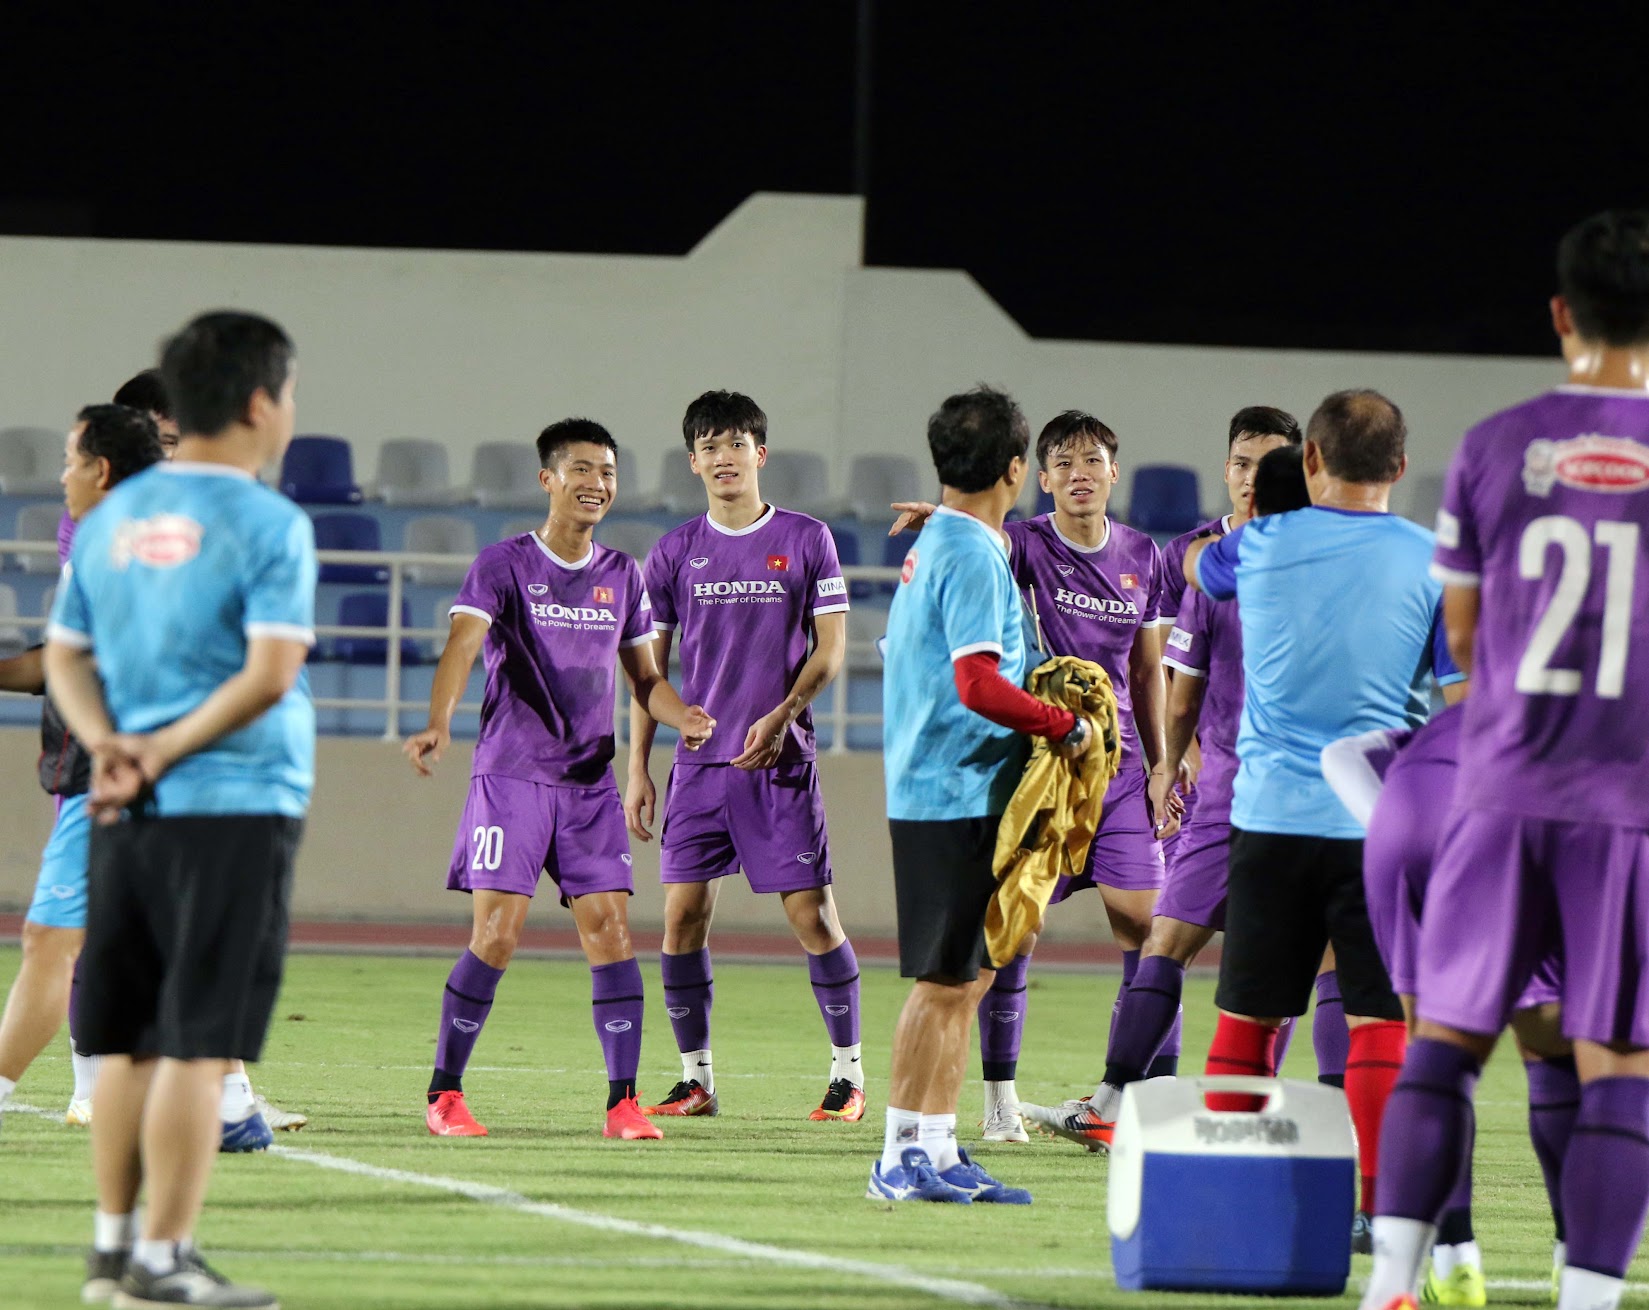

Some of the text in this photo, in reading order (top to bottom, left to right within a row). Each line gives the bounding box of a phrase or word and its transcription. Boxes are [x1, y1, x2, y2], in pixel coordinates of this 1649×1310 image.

[693, 580, 787, 597] HONDA
[529, 601, 618, 622] HONDA
[697, 598, 714, 606] The
[714, 597, 738, 605] Power
[750, 596, 783, 604] Dreams
[1054, 587, 1140, 615] HONDA
[1514, 515, 1640, 699] 21
[533, 617, 615, 631] The Power of Dreams
[1056, 603, 1137, 625] The Power of Dreams
[471, 825, 504, 871] 20
